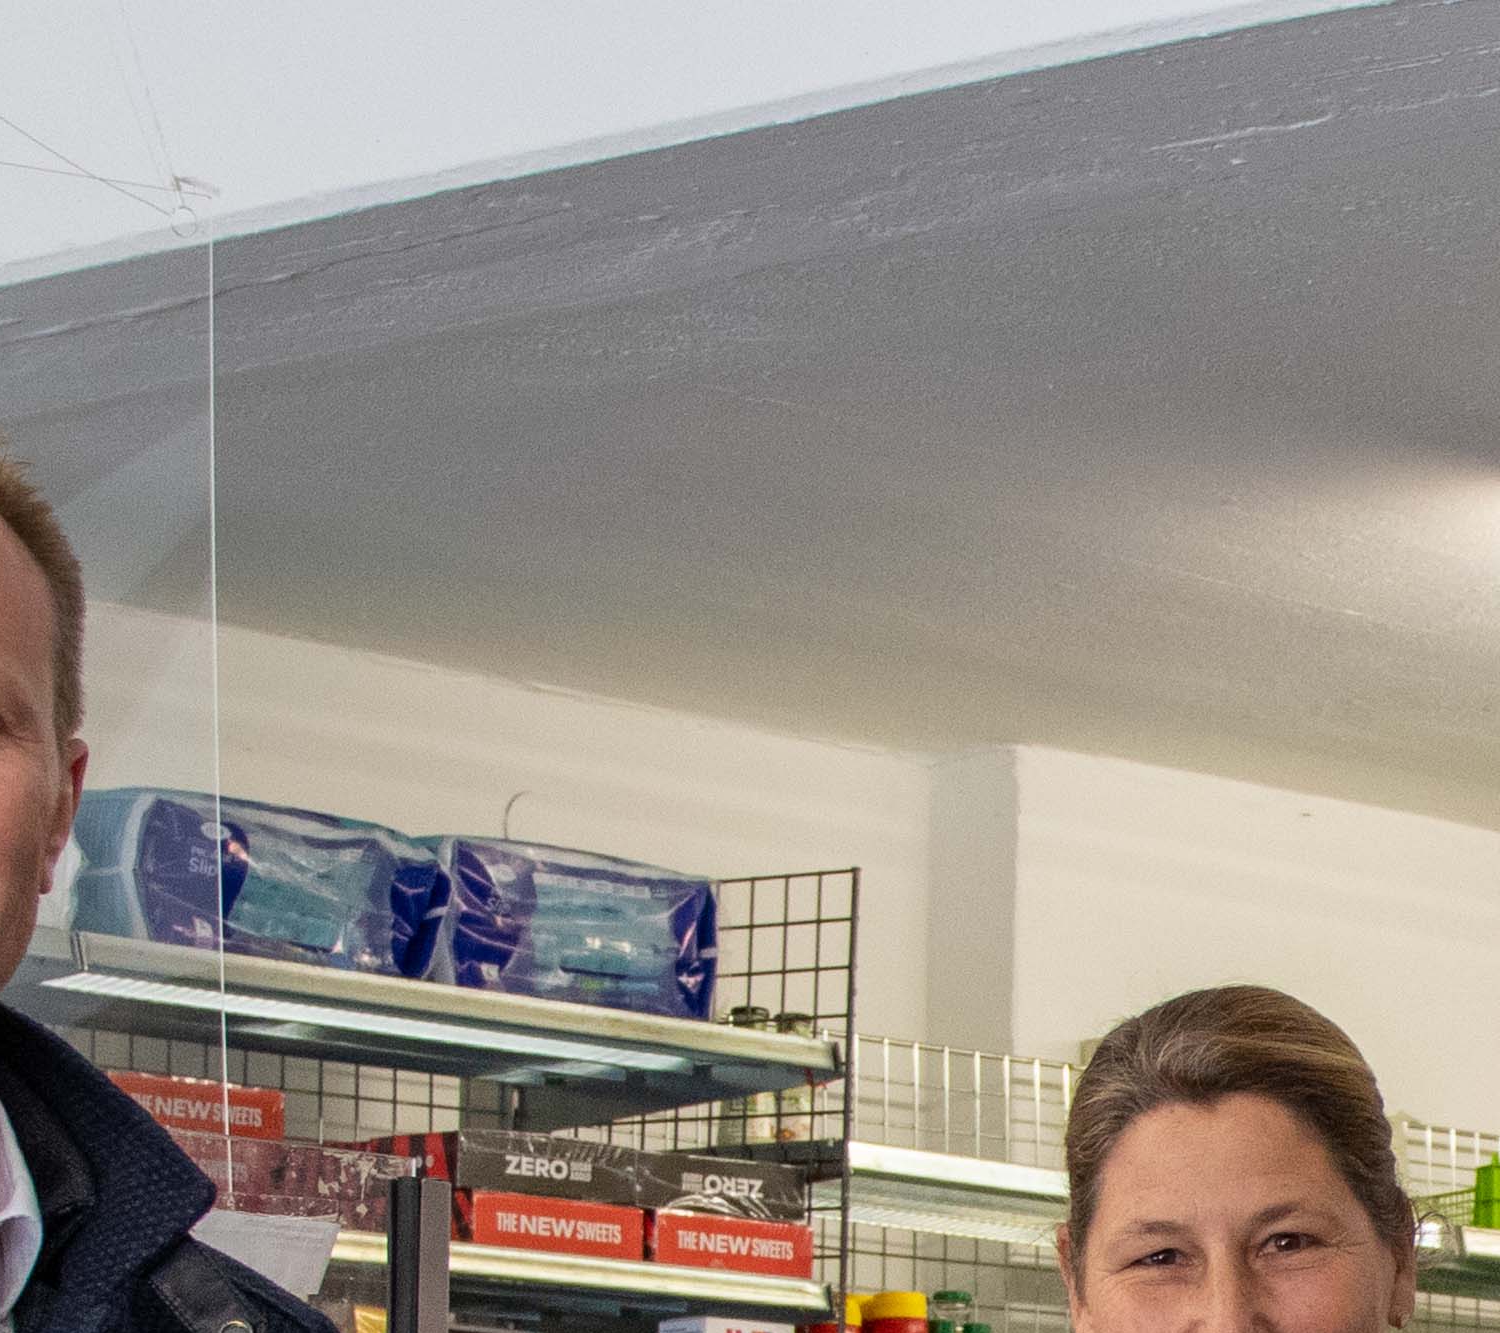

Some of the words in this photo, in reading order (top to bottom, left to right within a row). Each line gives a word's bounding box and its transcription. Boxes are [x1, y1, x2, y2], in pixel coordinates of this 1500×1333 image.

[154, 1096, 214, 1122] NEW
[213, 1105, 263, 1128] SWEETS
[504, 1154, 570, 1181] ZERO
[704, 1174, 765, 1199] ZERO
[495, 1211, 518, 1234] THE
[520, 1214, 576, 1239] NEW
[576, 1219, 623, 1245] SWEETS
[677, 1229, 700, 1250] THE
[700, 1232, 752, 1256] NEW
[751, 1240, 795, 1261] SWEETS
